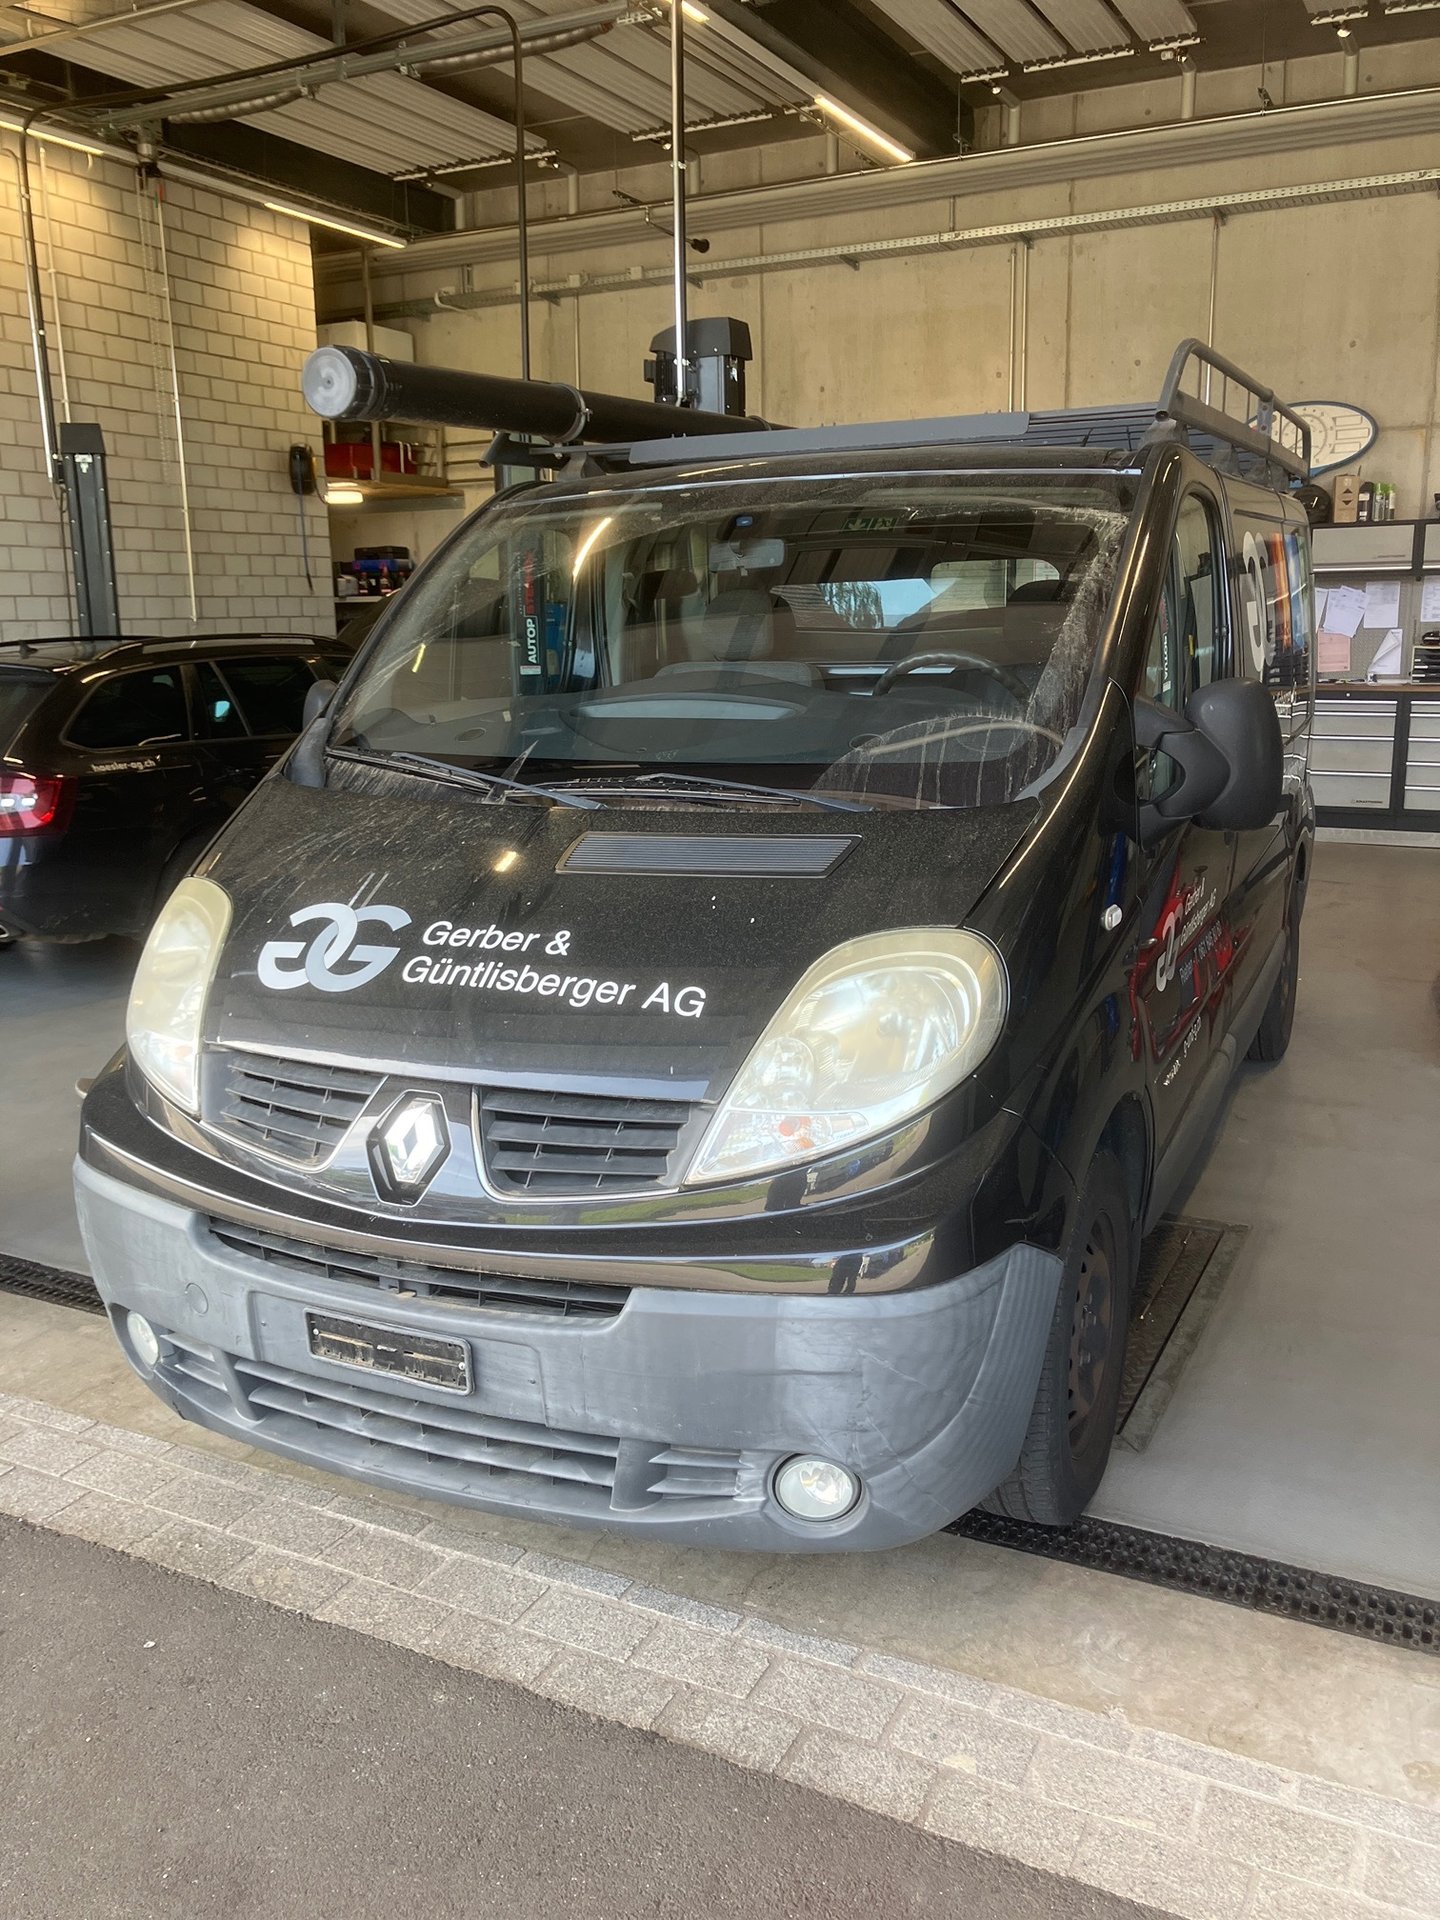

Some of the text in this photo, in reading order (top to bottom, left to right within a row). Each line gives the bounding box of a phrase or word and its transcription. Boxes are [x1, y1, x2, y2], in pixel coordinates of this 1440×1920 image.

[526, 618, 538, 664] AUTOP
[422, 920, 572, 956] Gerber &
[401, 955, 707, 1018] Güntlisberger AG
